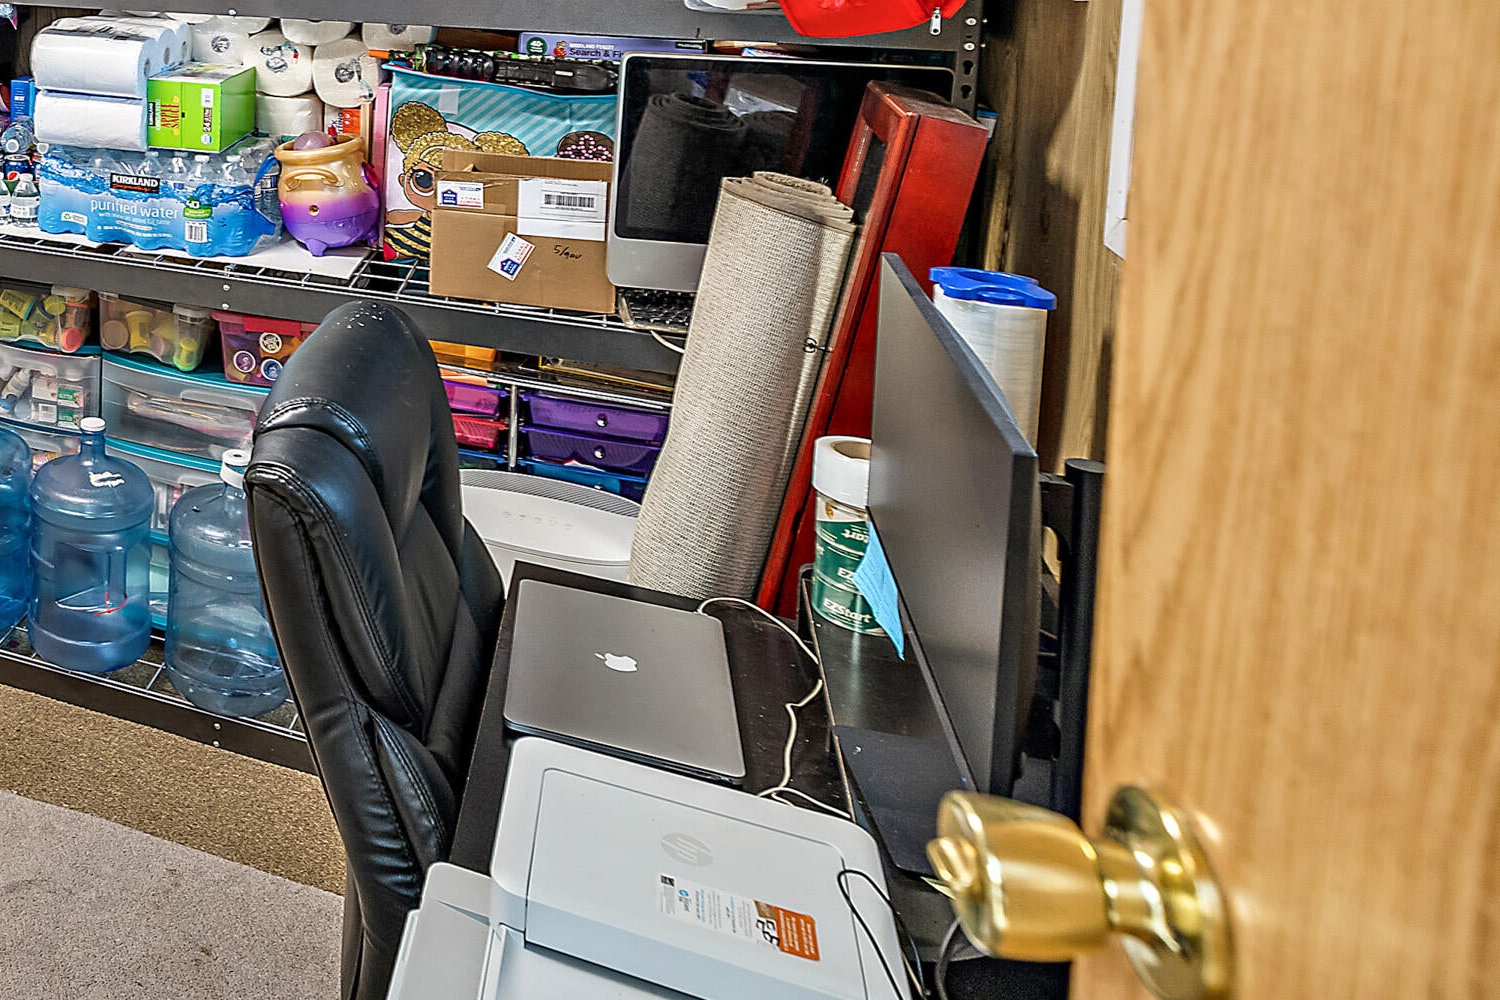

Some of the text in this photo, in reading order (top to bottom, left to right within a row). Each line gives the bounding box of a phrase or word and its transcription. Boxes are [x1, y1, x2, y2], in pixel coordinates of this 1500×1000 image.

[569, 48, 601, 57] Search
[160, 104, 171, 127] APPLE
[170, 104, 179, 128] SAUCE
[112, 174, 159, 187] KIRKLAND
[90, 199, 138, 215] purified
[140, 207, 179, 219] water
[822, 597, 873, 623] EZStart
